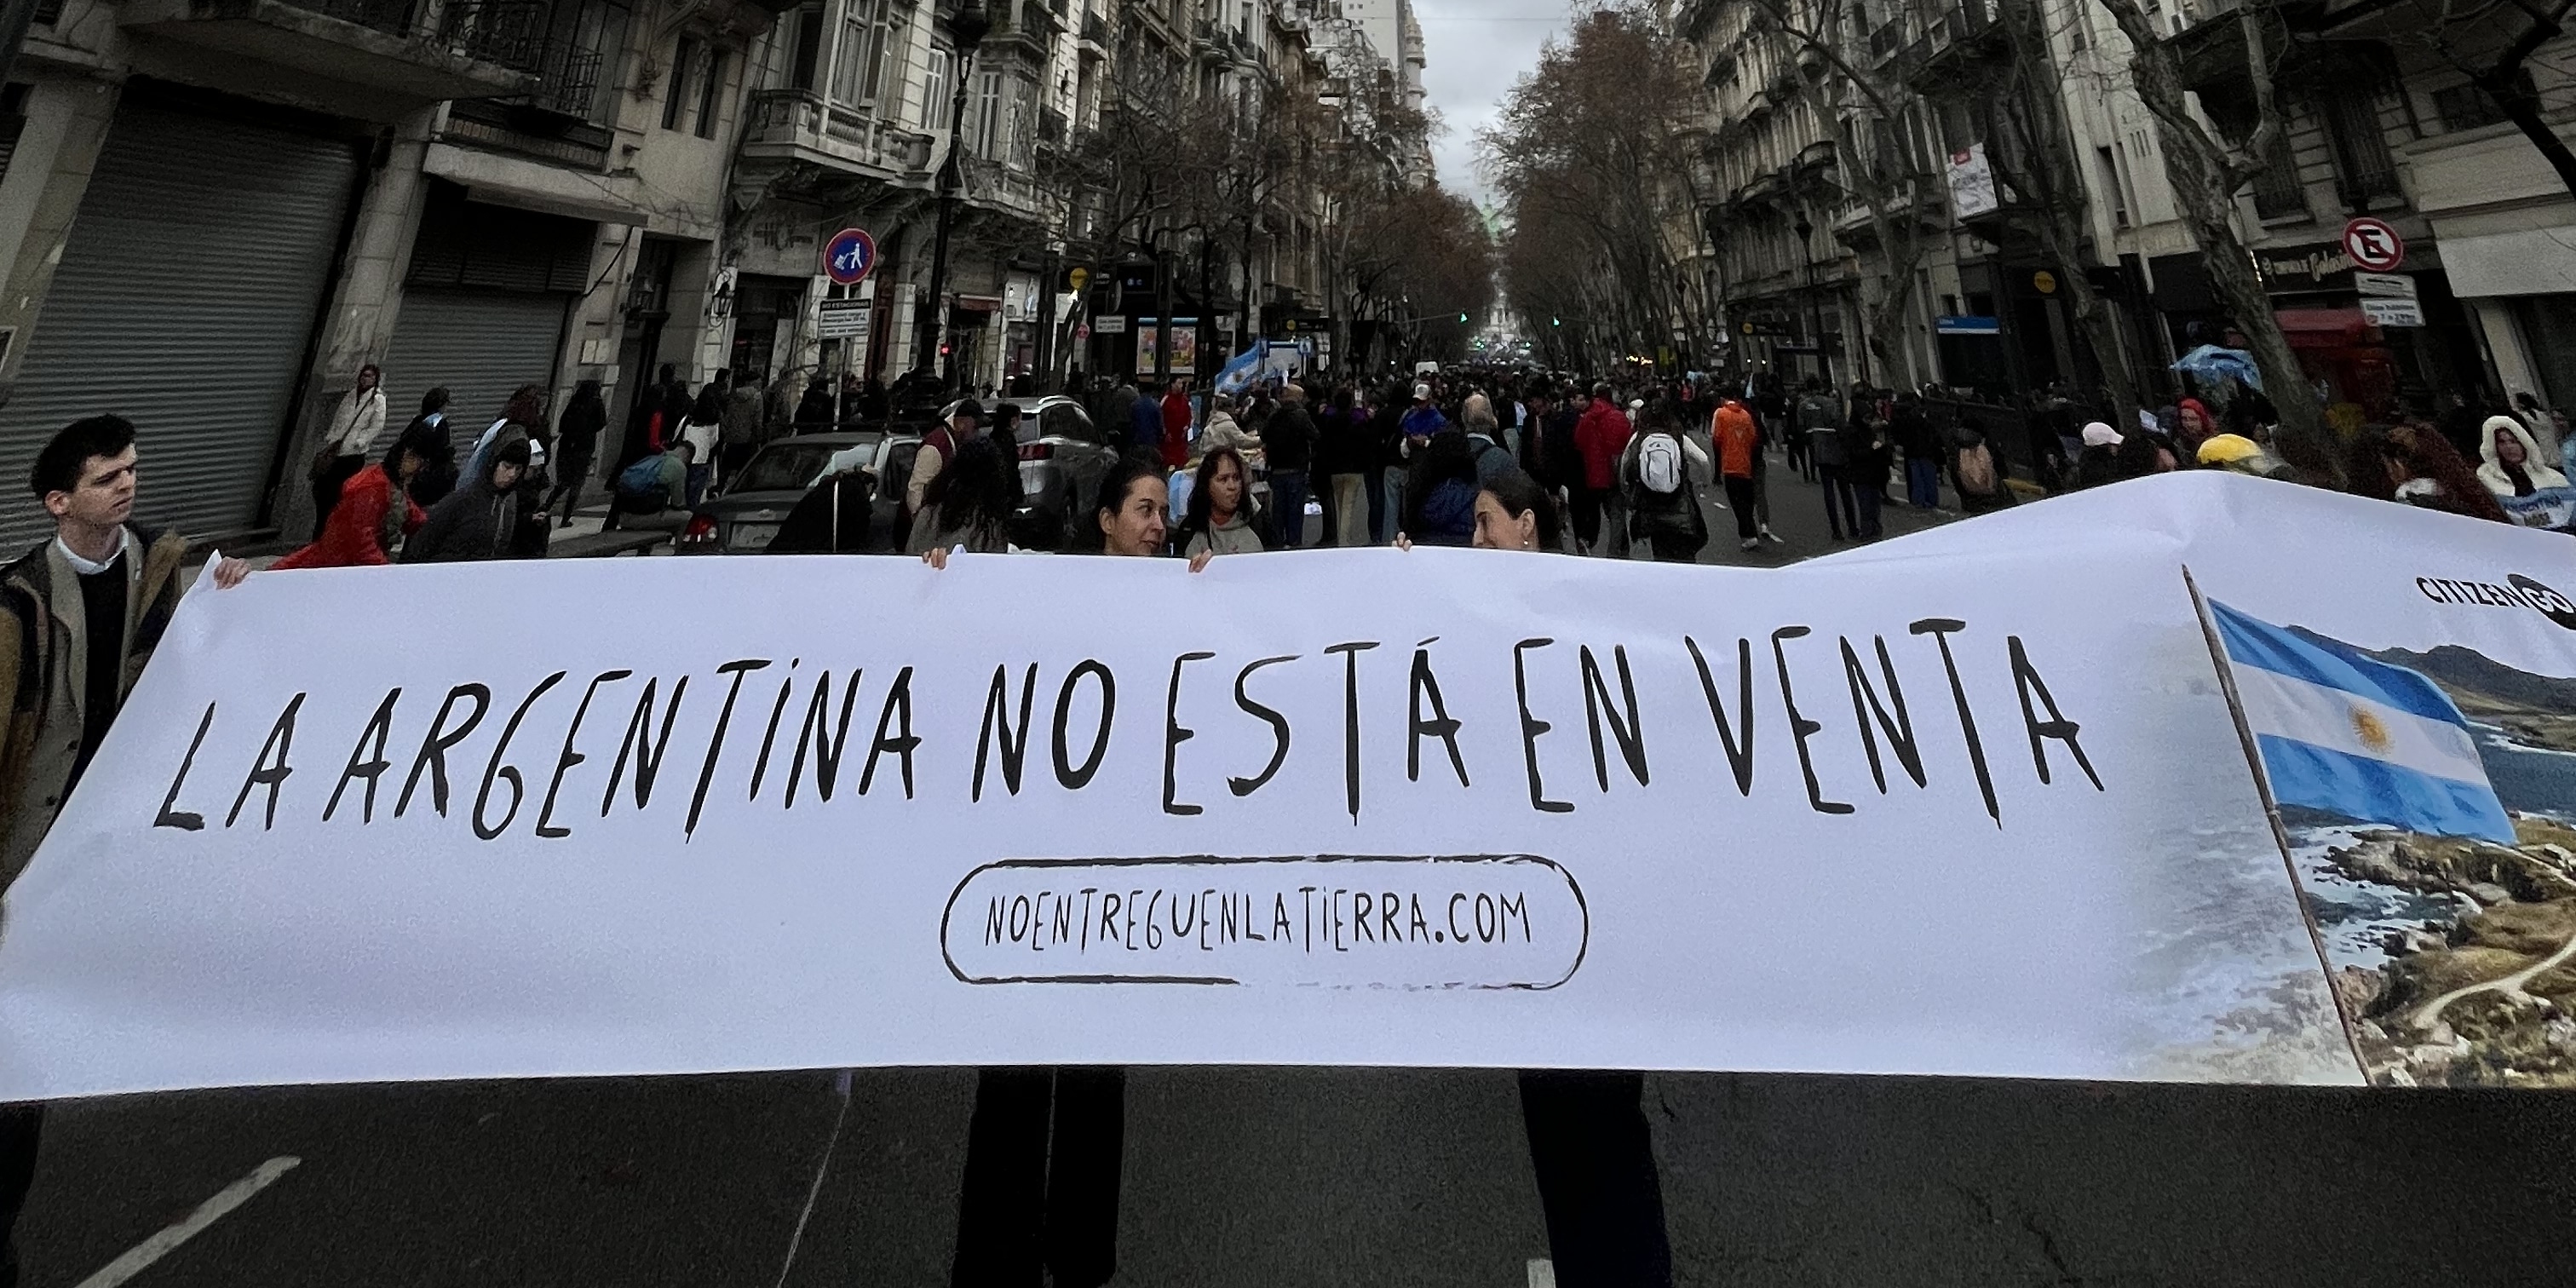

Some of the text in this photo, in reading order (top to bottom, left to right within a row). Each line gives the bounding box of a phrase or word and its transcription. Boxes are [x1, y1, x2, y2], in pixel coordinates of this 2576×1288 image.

[153, 618, 2105, 844] LA ARGENTINA NO ESTÁ EN VENTA
[985, 886, 1532, 954] NOENTREGUENLATIERRA.COM
